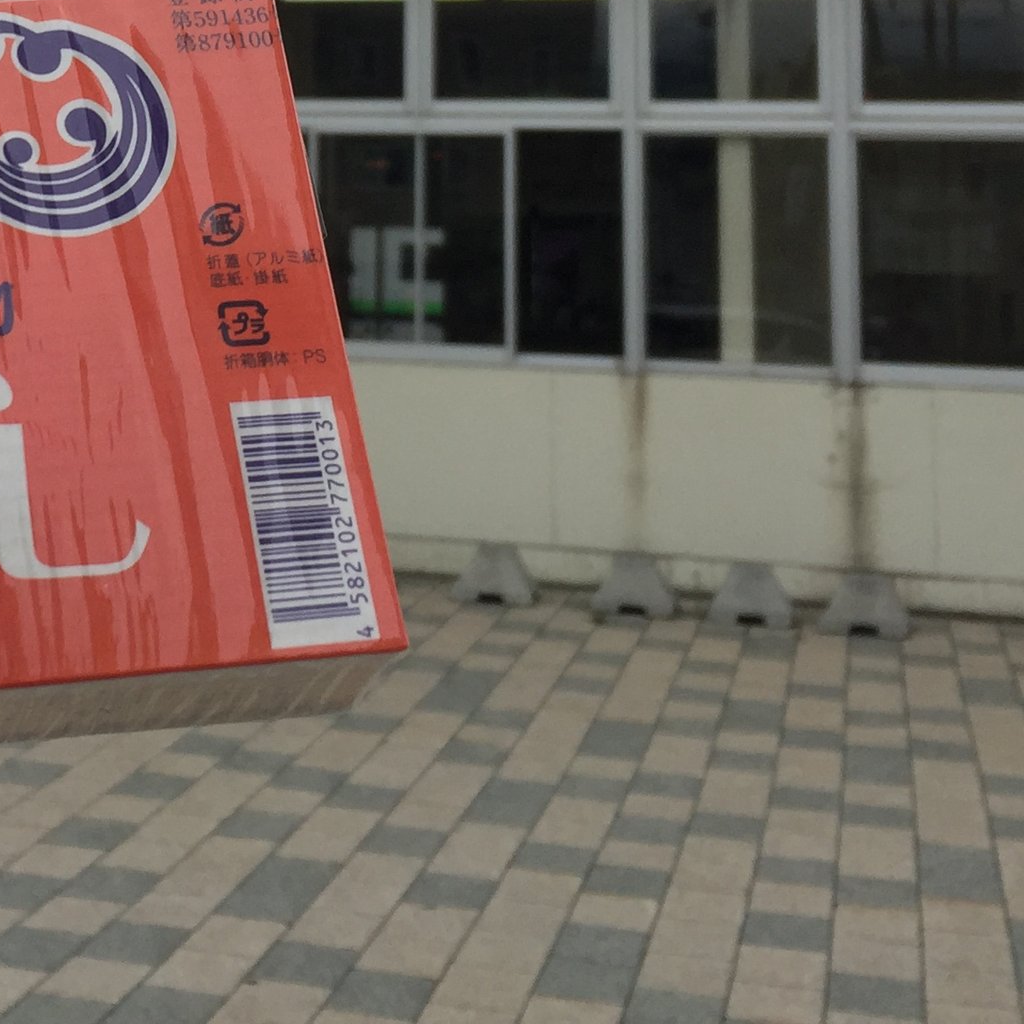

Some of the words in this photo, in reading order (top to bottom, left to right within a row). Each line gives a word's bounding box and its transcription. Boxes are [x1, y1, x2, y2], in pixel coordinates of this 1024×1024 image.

[171, 6, 269, 30] 第591436
[175, 30, 274, 54] 第879100
[232, 311, 265, 336] プラ
[303, 348, 327, 364] PS
